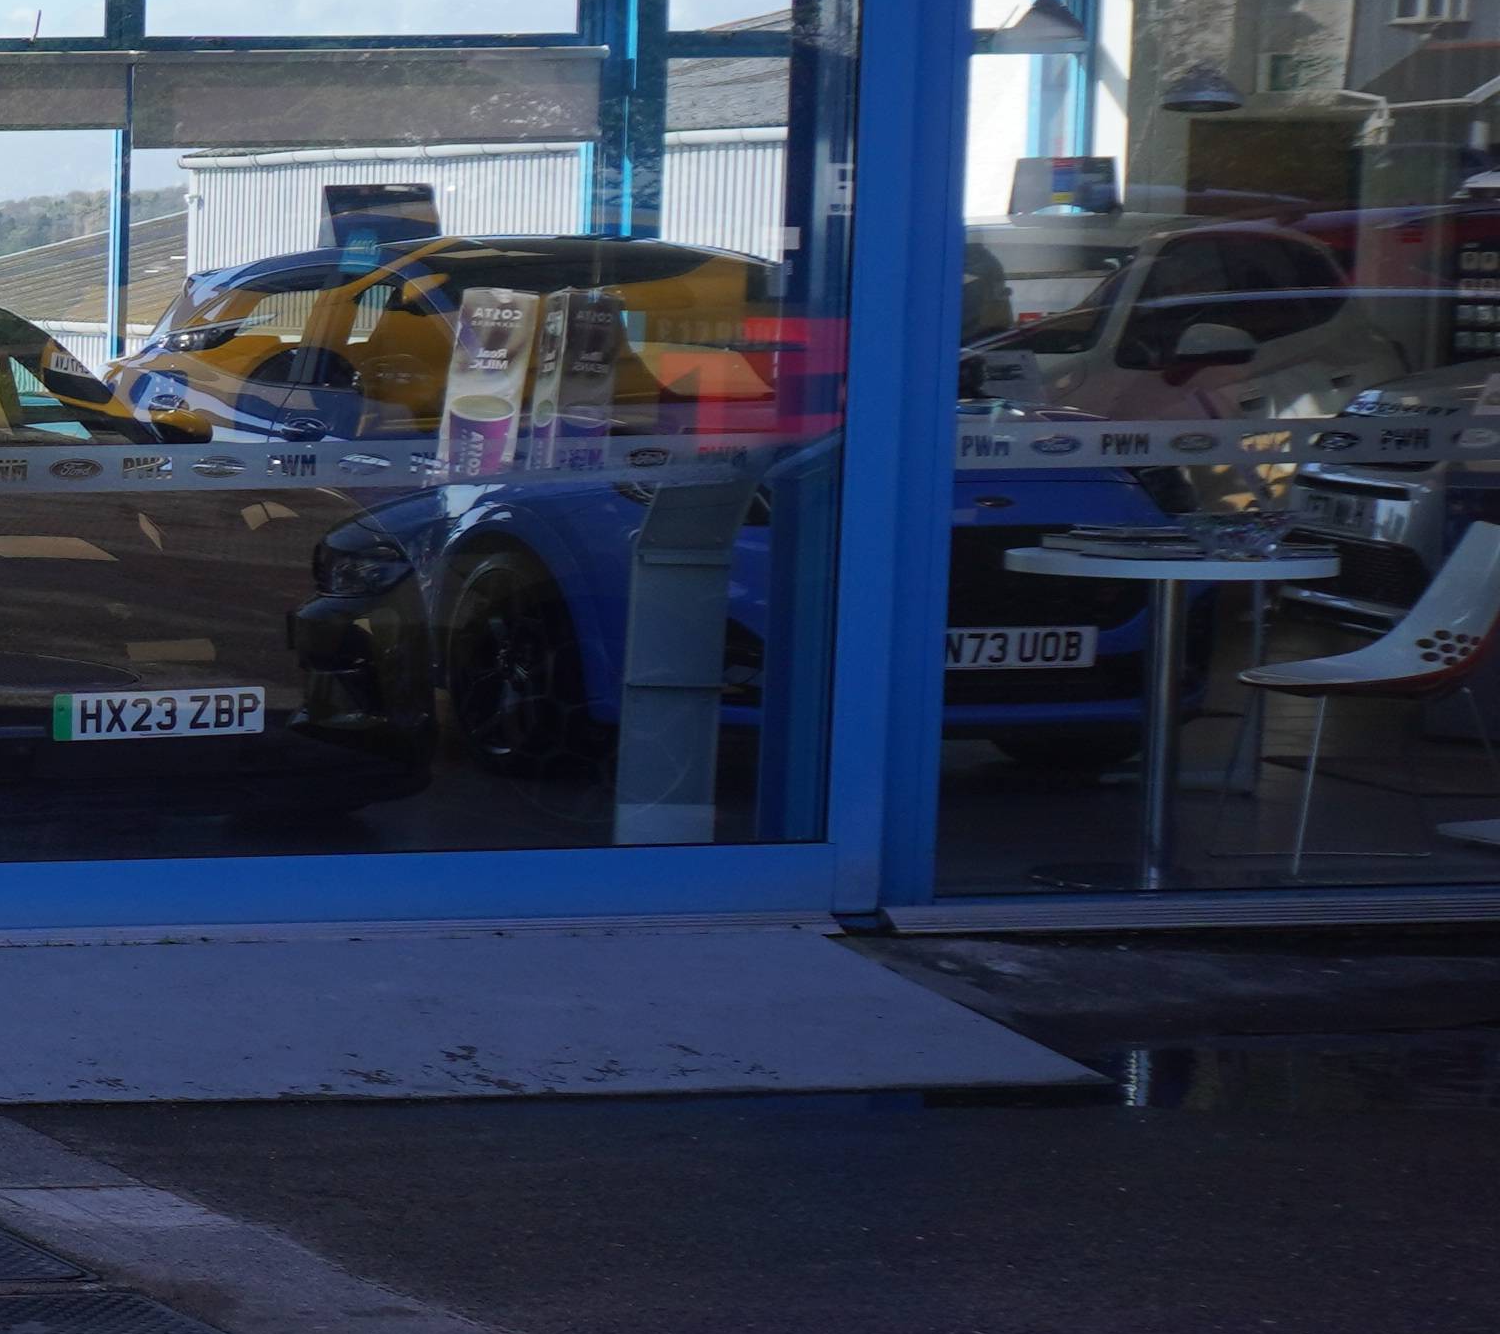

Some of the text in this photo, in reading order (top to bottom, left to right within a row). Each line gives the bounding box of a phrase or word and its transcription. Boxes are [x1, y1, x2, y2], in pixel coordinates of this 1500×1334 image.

[1102, 433, 1149, 454] PWM
[80, 693, 261, 734] HX23 ZBP
